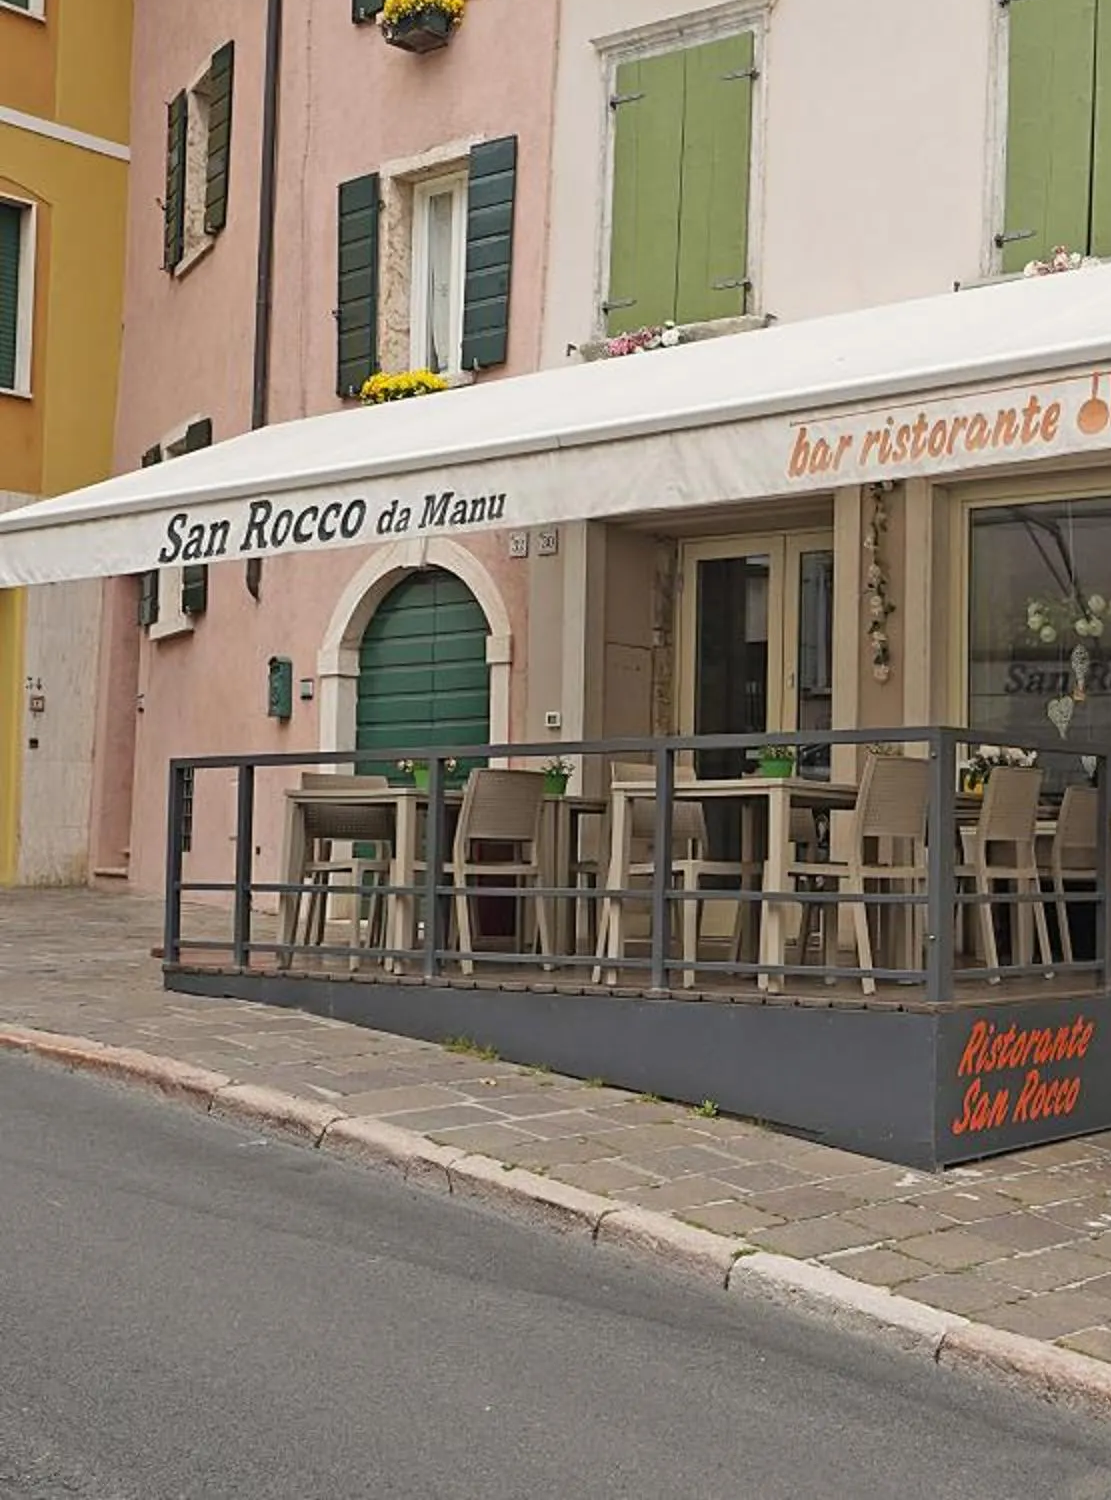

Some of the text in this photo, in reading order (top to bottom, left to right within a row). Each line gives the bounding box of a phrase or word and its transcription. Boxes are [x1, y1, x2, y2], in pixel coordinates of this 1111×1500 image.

[787, 394, 1061, 479] bar ristorante
[157, 491, 507, 564] San Rocco da Manu
[1004, 662, 1070, 695] San
[957, 1014, 1095, 1077] Ristorante
[952, 1068, 1082, 1136] San Rocco
